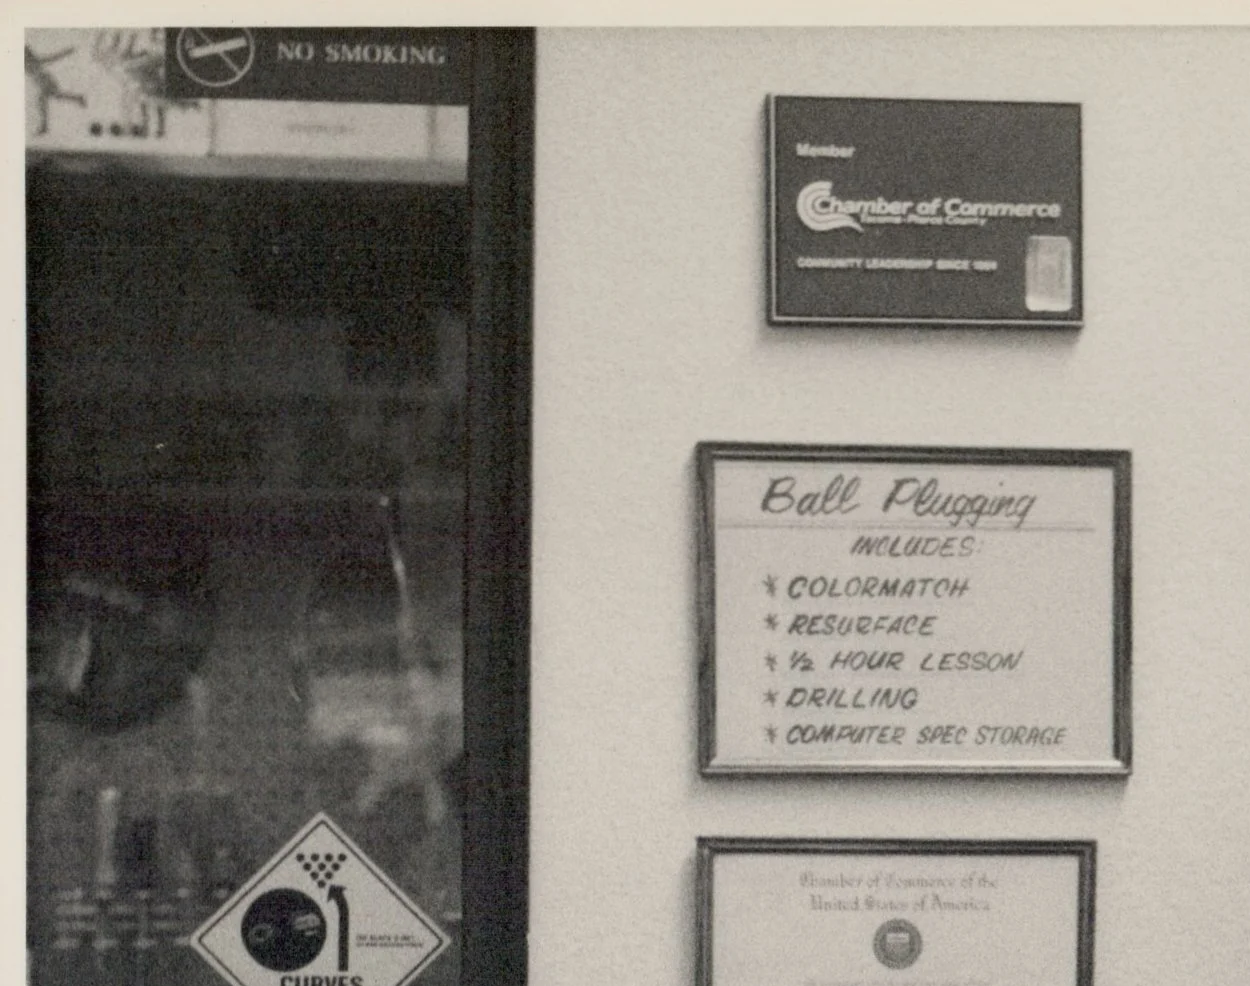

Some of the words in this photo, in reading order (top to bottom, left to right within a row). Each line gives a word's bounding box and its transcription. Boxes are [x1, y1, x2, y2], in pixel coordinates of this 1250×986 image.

[277, 41, 313, 61] NO
[324, 44, 446, 65] SMOKING
[796, 142, 855, 158] Member
[917, 198, 944, 217] of
[944, 198, 1061, 219] Commerce
[760, 474, 862, 516] Ball
[883, 477, 1037, 528] Plugging
[787, 575, 972, 601] COLORMATCH
[788, 614, 937, 637] RESURFACE
[830, 650, 905, 672] HOUR
[920, 650, 1024, 672] LESSON
[785, 688, 919, 710] DRILLING
[786, 723, 905, 745] COMPUTER
[916, 725, 968, 746] SPEC
[975, 725, 1067, 747] STORAGE
